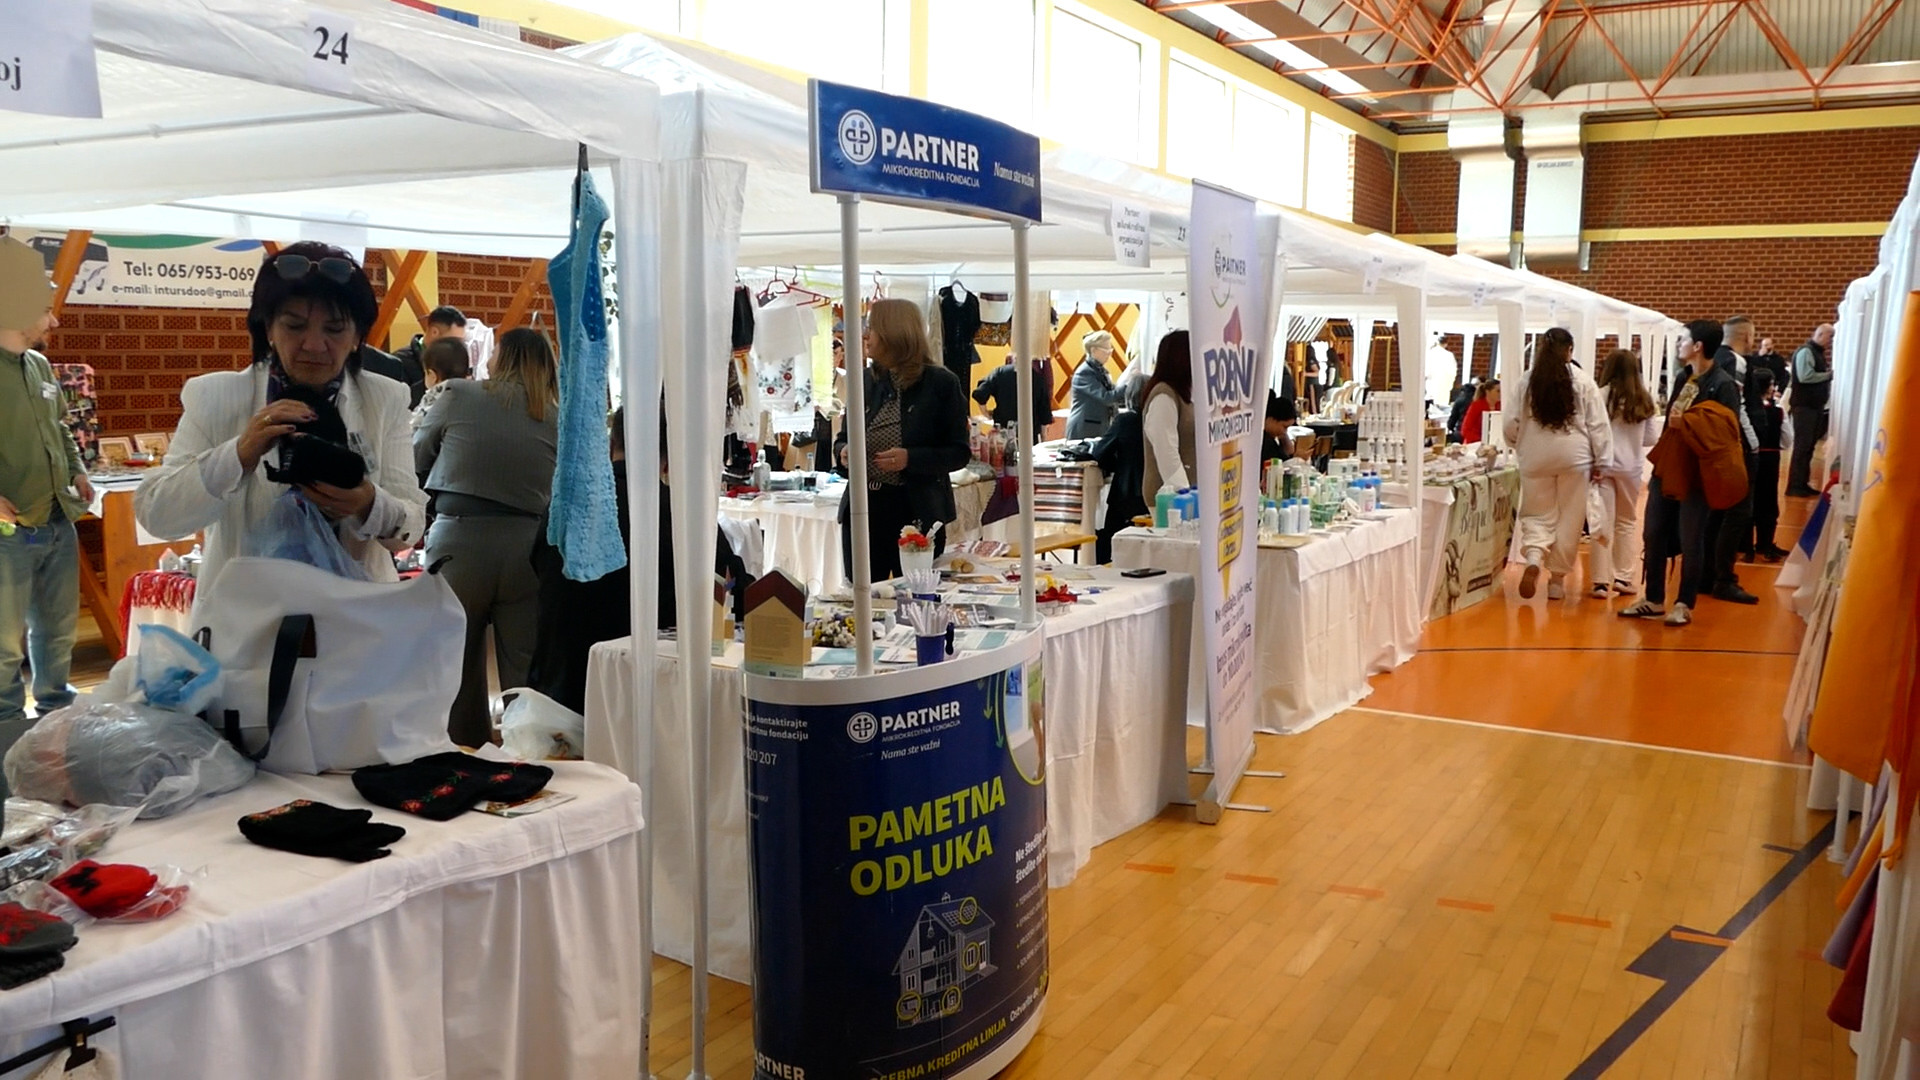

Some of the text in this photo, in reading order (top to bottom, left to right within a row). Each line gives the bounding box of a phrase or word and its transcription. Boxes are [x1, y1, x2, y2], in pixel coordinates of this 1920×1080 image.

[312, 25, 350, 65] 24
[0, 57, 21, 91] oj
[881, 127, 979, 172] PARTNER
[882, 163, 980, 188] MIKROKREDITNA FONDACIJA
[994, 161, 1012, 181] Nama
[123, 261, 256, 282] Tel: 065/953-069
[112, 285, 255, 299] e-mail: intursdoo@gmail.c
[756, 714, 808, 730] kontaktirajte
[881, 701, 960, 733] PARTNER
[769, 728, 809, 742] fondaciju
[759, 751, 778, 766] 207
[881, 738, 941, 760] Nama ste važni
[850, 775, 1006, 851] PAMETNA
[850, 825, 993, 896] ODLUKA
[927, 1037, 979, 1073] KREDITNA
[980, 1017, 1007, 1045] LINIJA
